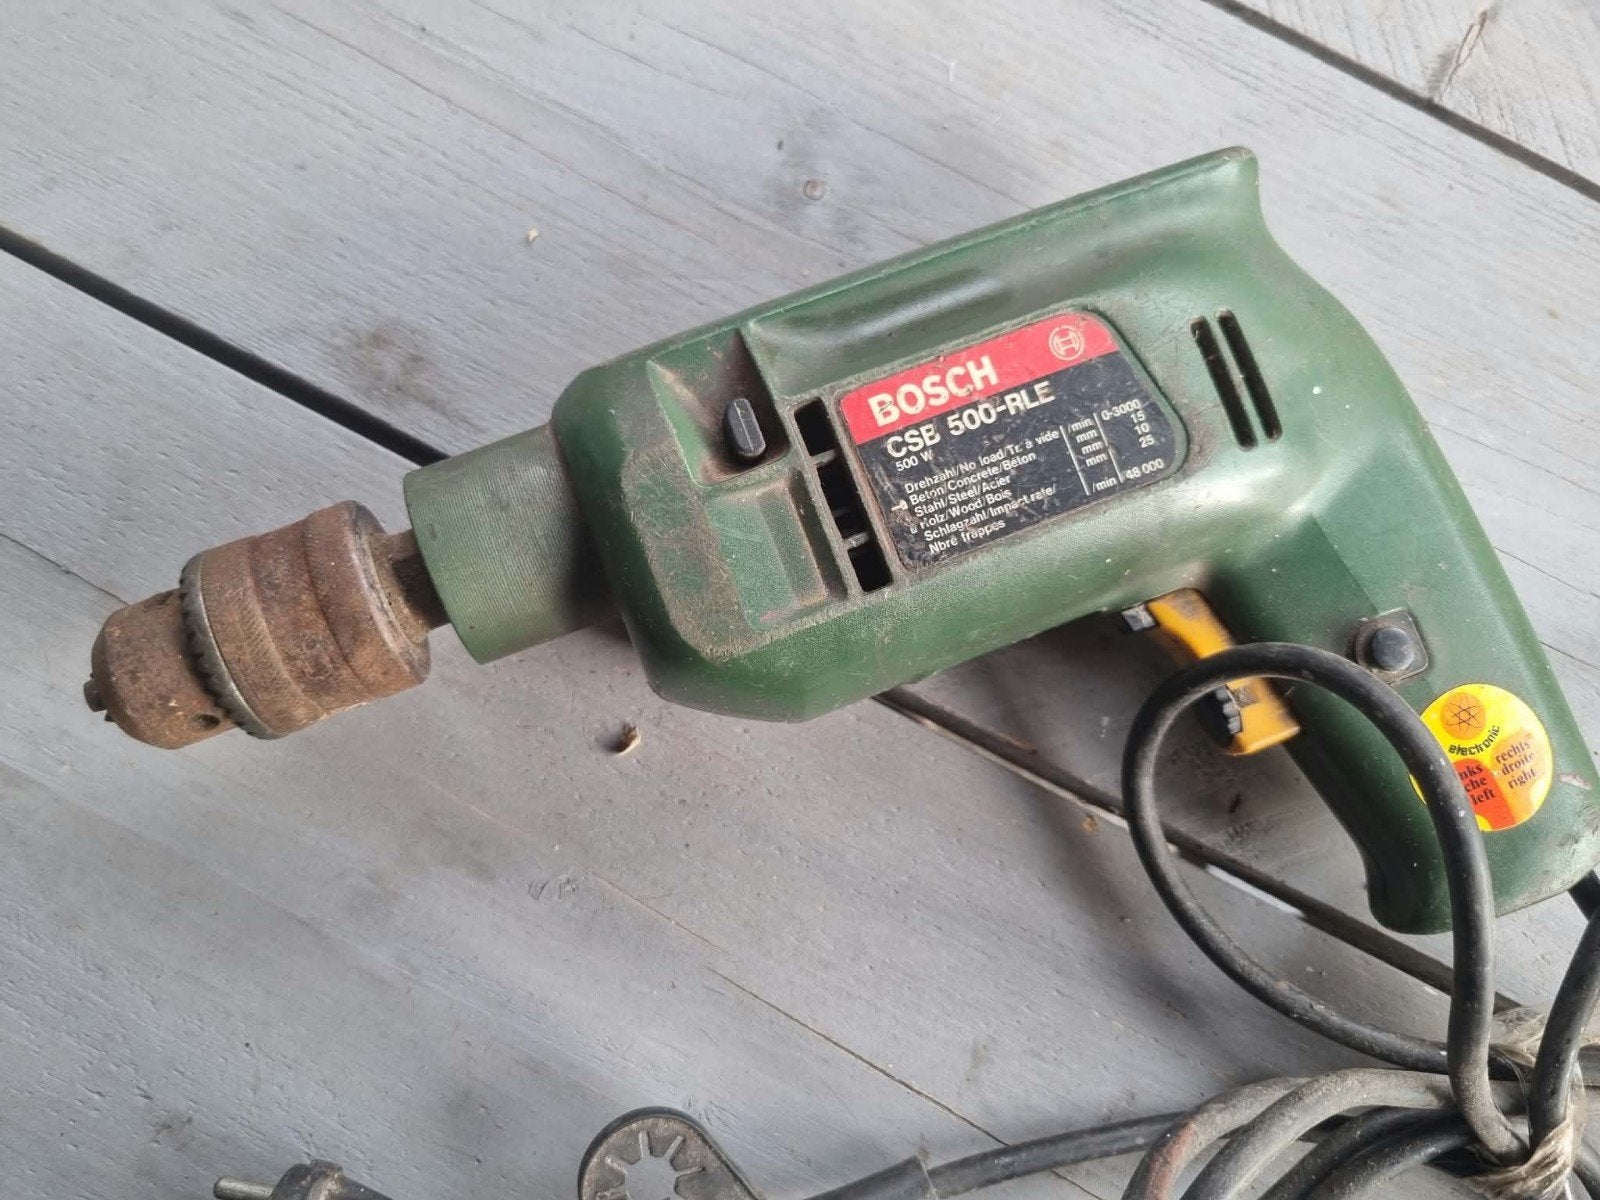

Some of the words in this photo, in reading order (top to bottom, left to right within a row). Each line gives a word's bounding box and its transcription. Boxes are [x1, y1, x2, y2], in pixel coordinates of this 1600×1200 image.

[867, 355, 999, 427] BOSCH
[886, 423, 941, 458] CSB
[947, 381, 1055, 436] 500-RLE
[1101, 399, 1140, 421] 0-3000
[1130, 411, 1146, 424] 15
[1075, 429, 1098, 443] mm
[1134, 422, 1150, 435] 10
[1081, 441, 1103, 455] mm
[1139, 434, 1155, 448] 25
[895, 455, 919, 472] 500
[920, 449, 933, 463] W
[904, 462, 976, 494] Drehzahl/No
[1024, 438, 1034, 449] à
[1035, 429, 1060, 445] vide
[1085, 453, 1107, 467] mm
[1141, 458, 1164, 474] 000
[909, 452, 1036, 506] Beton/Concrete/Béton
[1093, 477, 1117, 493] /min
[914, 475, 1011, 517] Stahl/Steel/Acier
[920, 488, 1012, 529] Holz/Wood/Bois
[928, 535, 958, 554] Nbre
[960, 518, 1006, 544] frappes
[1448, 725, 1500, 756] electronic
[1495, 742, 1530, 763] rechts
[1501, 752, 1534, 775] droite
[1508, 768, 1537, 789] right
[1470, 788, 1495, 805] left
